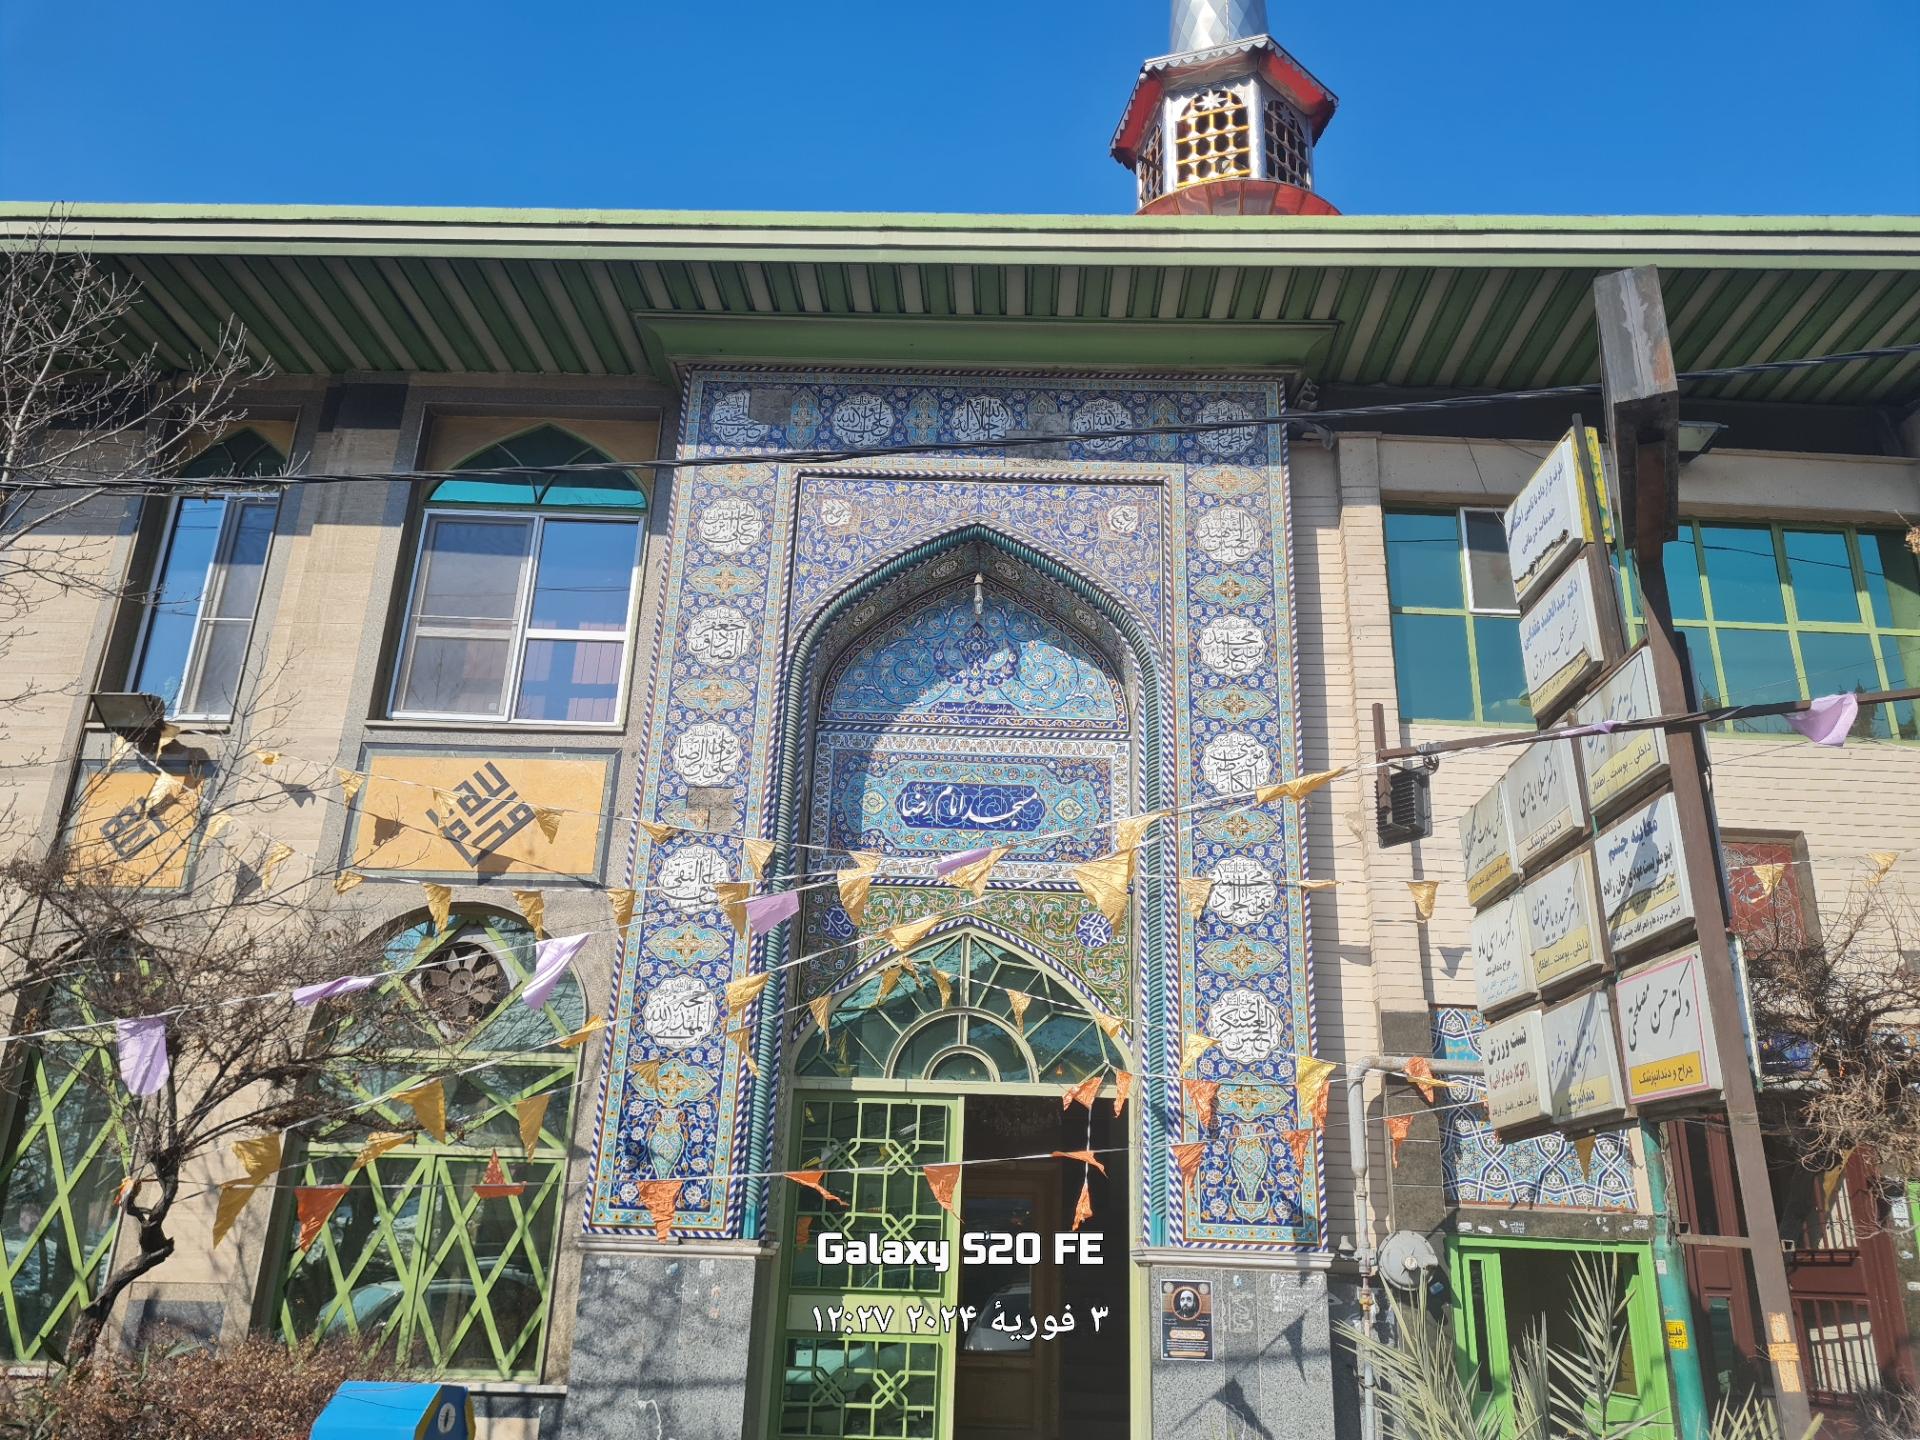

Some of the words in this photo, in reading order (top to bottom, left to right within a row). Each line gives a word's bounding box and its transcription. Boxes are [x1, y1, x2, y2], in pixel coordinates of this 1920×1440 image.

[901, 792, 934, 817] رضا
[935, 785, 965, 823] امام
[963, 792, 1038, 828] مسجد
[1650, 989, 1668, 1034] حسن
[1664, 960, 1690, 1038] دکتر
[1510, 1026, 1527, 1048] تست
[1638, 1069, 1672, 1086] دندانپزشک
[1677, 1064, 1693, 1082] جراح
